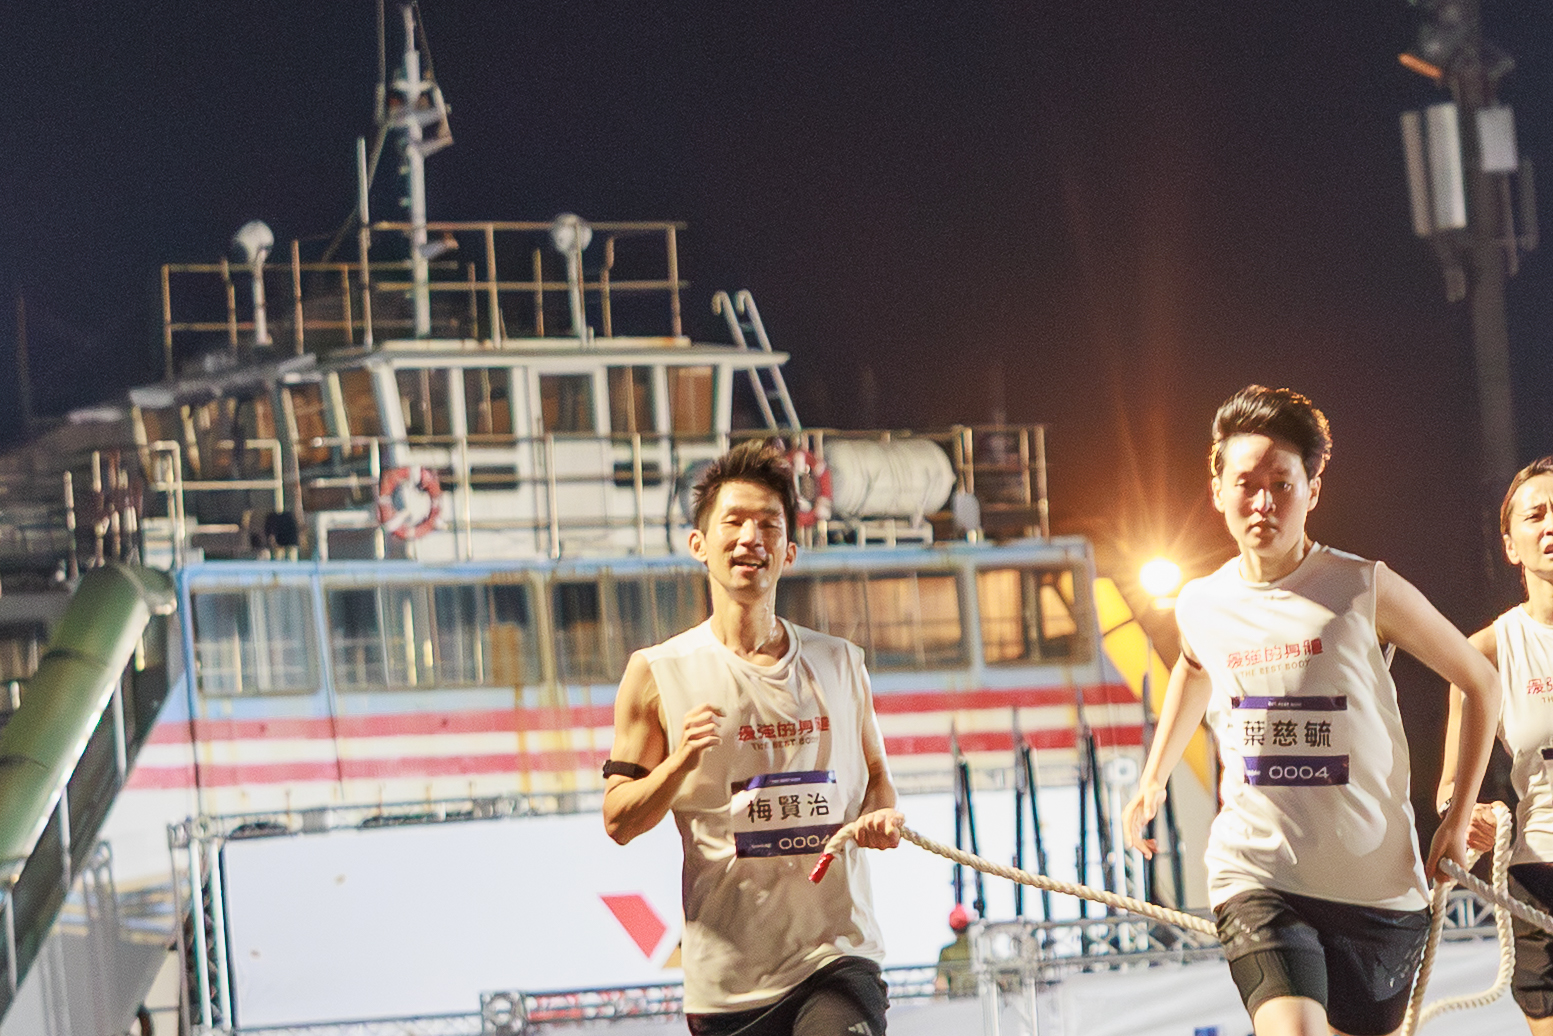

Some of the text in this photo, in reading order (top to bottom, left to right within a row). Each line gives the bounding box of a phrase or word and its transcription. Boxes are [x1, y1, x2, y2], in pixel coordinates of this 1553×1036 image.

[1241, 659, 1311, 678] THE BEST BODY
[1243, 719, 1332, 747] 葉慈毓
[1268, 765, 1330, 779] 0004
[747, 792, 830, 823] 梅賢治
